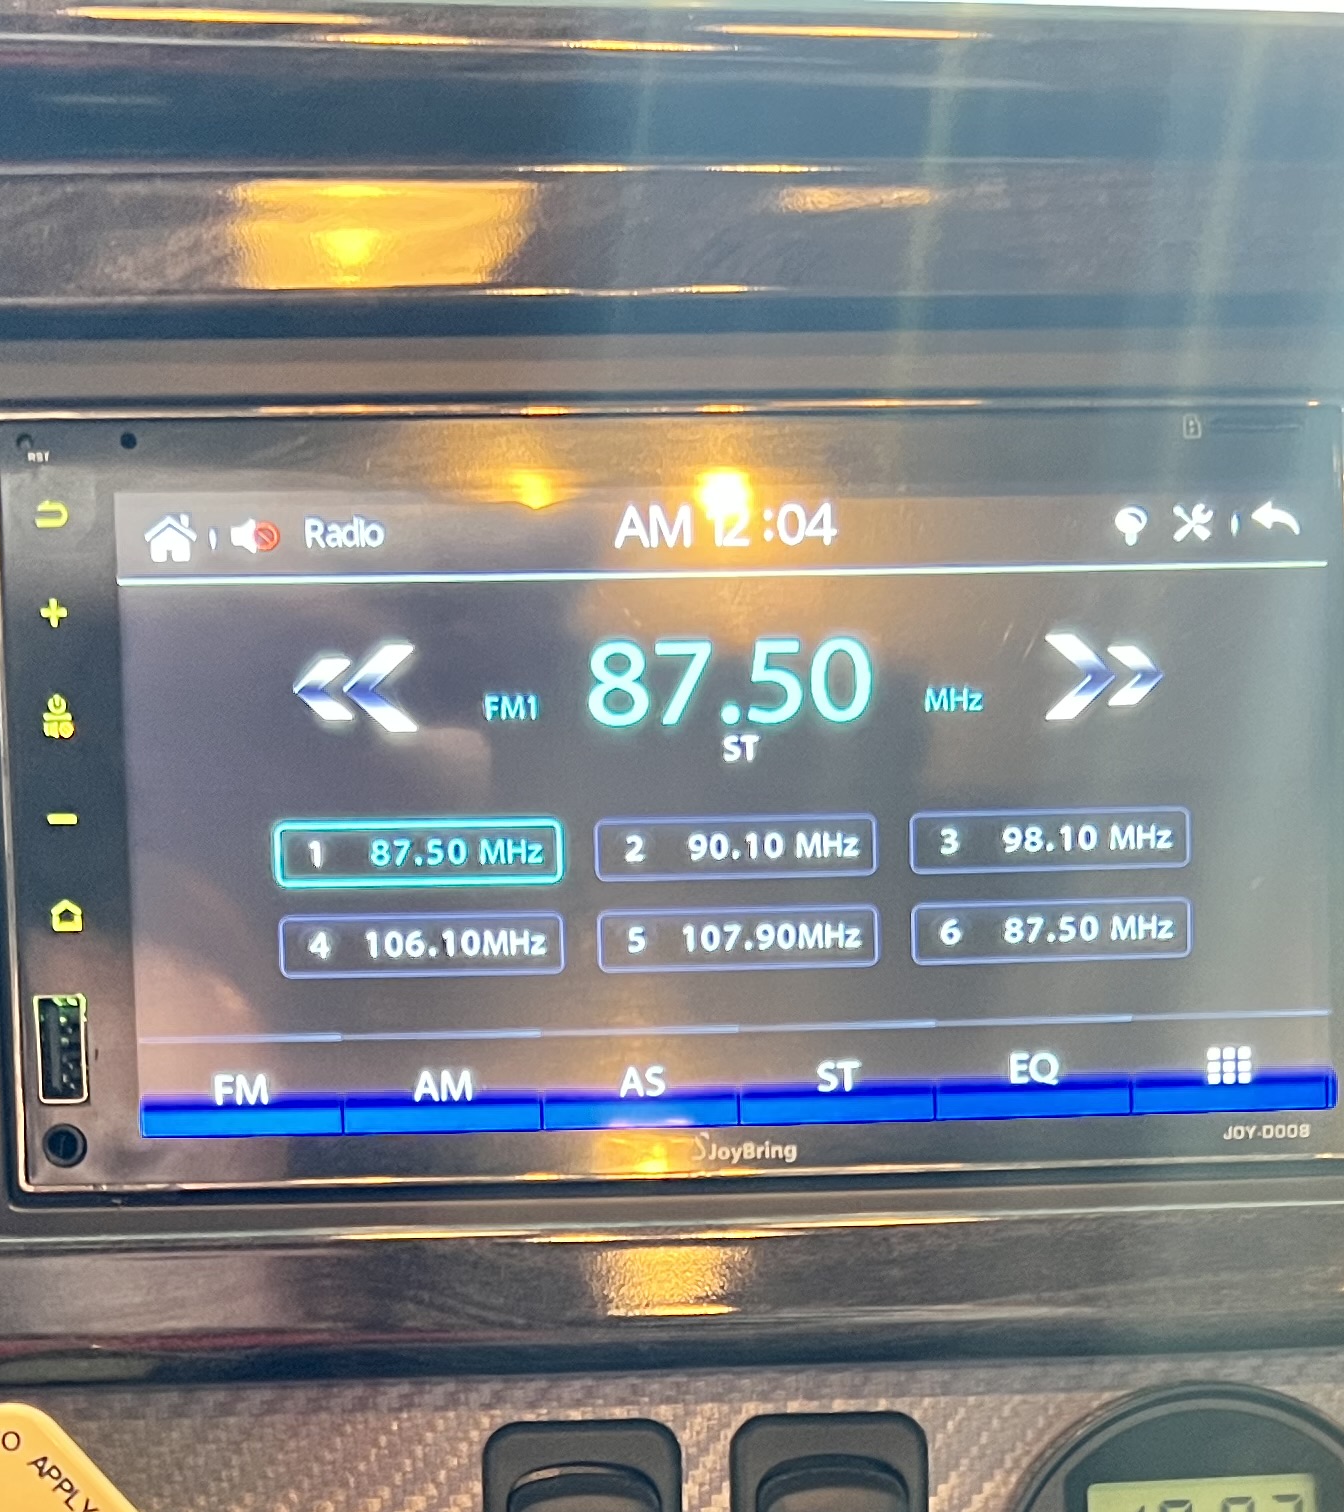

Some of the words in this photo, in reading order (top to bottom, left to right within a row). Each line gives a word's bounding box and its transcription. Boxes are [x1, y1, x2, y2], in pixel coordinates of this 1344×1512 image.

[305, 515, 385, 549] Radio
[614, 503, 692, 548] AM
[587, 636, 873, 727] 87.50
[924, 686, 984, 713] MHz
[485, 694, 540, 721] FM1
[722, 734, 759, 762] ST
[308, 840, 323, 867] 1
[370, 838, 468, 867] 87.50
[479, 838, 545, 867] MHz
[624, 834, 646, 862] 2
[687, 832, 785, 861] 90.10
[795, 830, 861, 859] MHz
[939, 827, 960, 855] 3
[1002, 825, 1098, 854] 98.10
[1109, 824, 1174, 851] MHz
[308, 932, 331, 960] 4
[364, 928, 548, 960] 106.10MHz
[626, 926, 647, 954] 5
[682, 923, 863, 953] 107.90MHz
[940, 919, 962, 946] 6
[1003, 916, 1099, 944] 87.50
[1110, 915, 1175, 941] MHz
[619, 1066, 667, 1098] AS
[816, 1060, 861, 1093] ST
[1009, 1052, 1061, 1087] EQ
[214, 1074, 270, 1106] FM
[413, 1070, 474, 1103] AM
[708, 1140, 797, 1164] JoyBring
